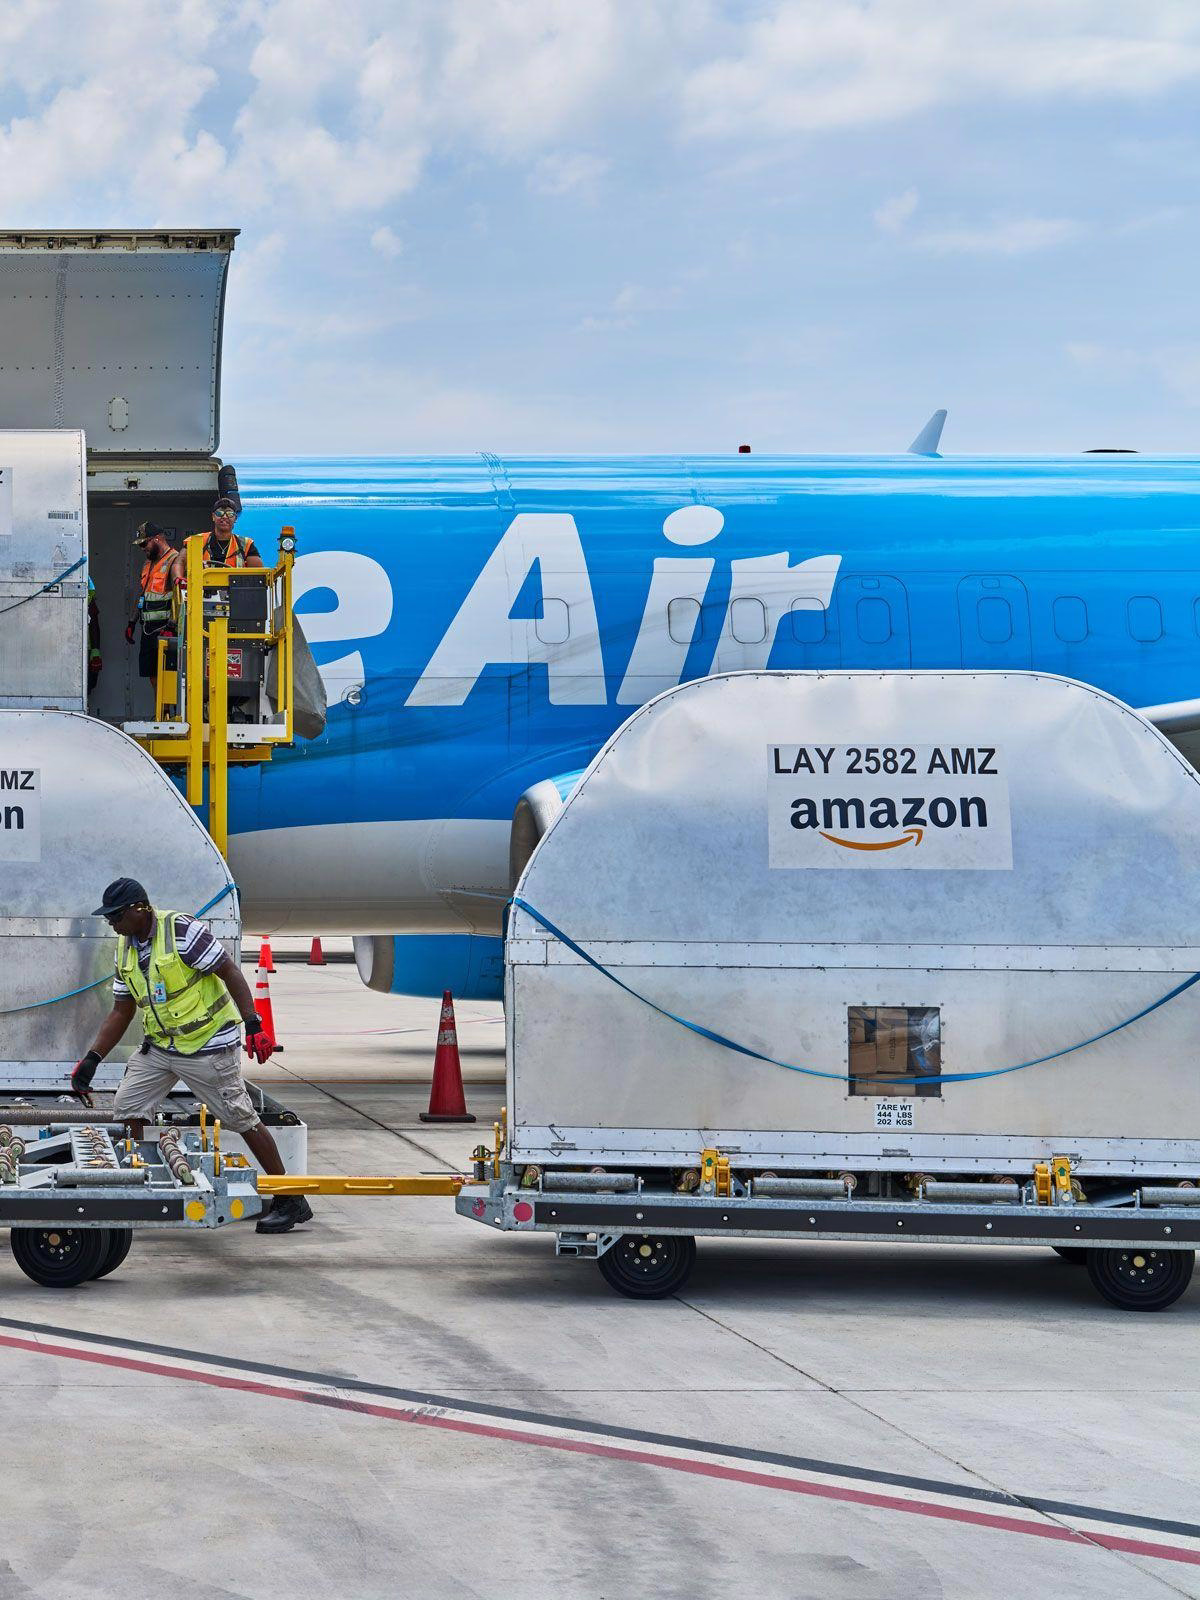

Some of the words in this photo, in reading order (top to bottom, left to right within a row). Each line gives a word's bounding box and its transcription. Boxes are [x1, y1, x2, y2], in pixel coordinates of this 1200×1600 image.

[404, 506, 843, 707] Air
[774, 748, 836, 774] LAY
[845, 747, 917, 775] 2582
[926, 748, 998, 775] AMZ
[790, 795, 988, 830] amazon
